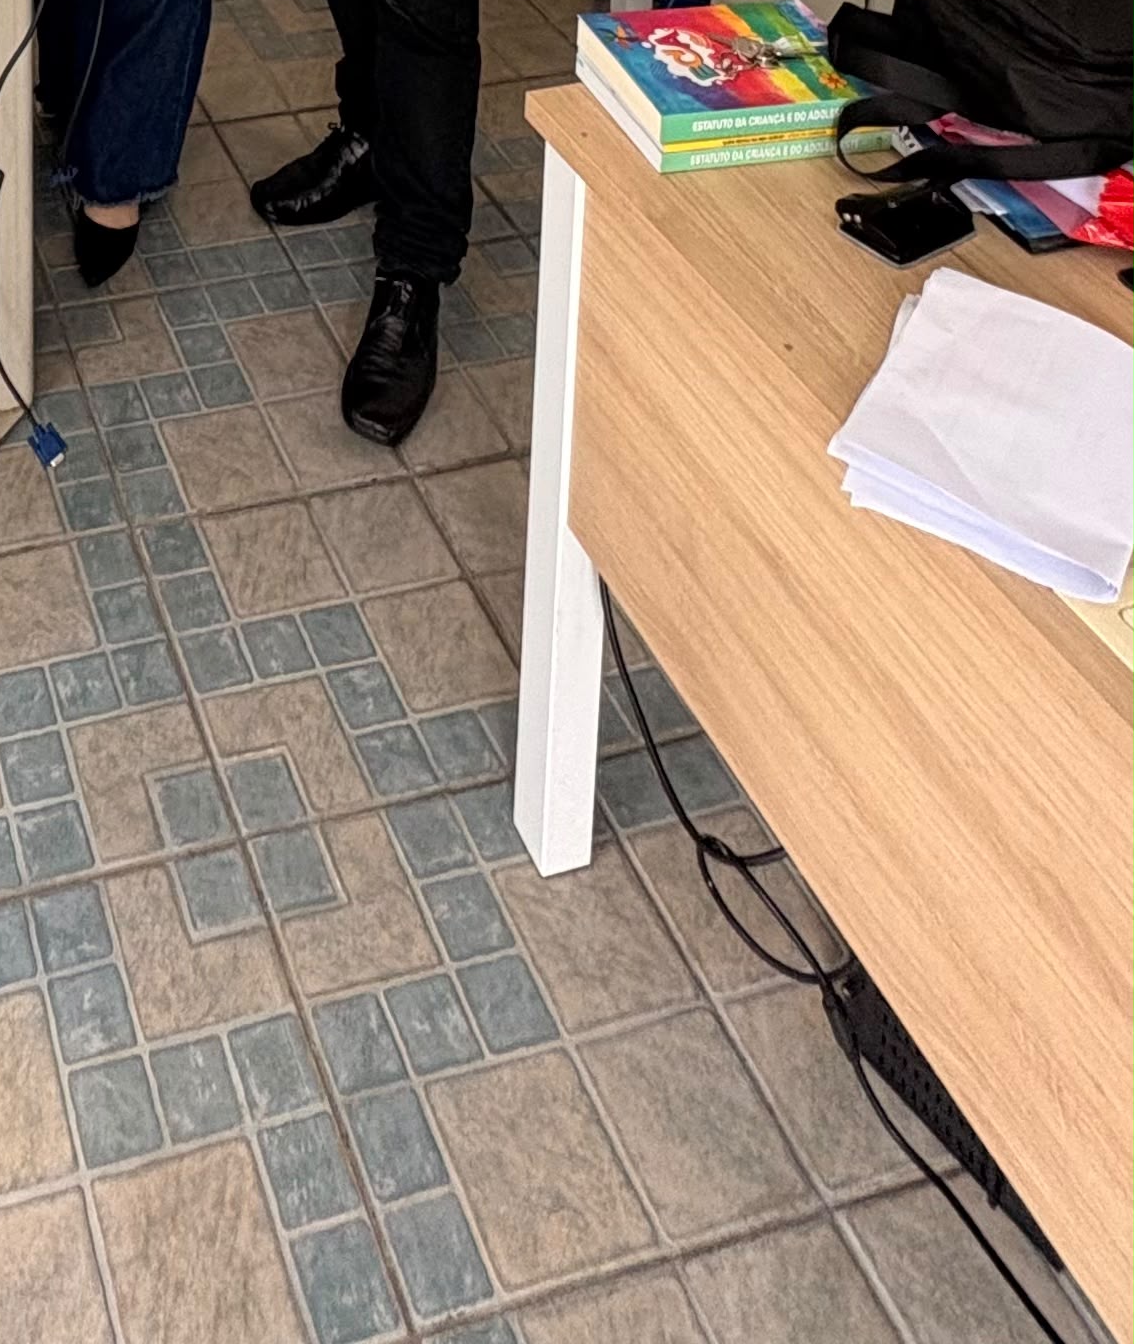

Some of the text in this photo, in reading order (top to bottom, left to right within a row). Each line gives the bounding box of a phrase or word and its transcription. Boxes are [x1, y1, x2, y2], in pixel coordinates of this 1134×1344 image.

[692, 117, 733, 132] ESTATUTO
[734, 116, 747, 128] DA
[748, 111, 785, 127] CRIANÇA
[794, 110, 806, 123] DO
[690, 150, 731, 166] ESTATUTO
[731, 149, 744, 162] DA
[745, 144, 781, 160] CRIANÇA
[790, 143, 802, 156] DO
